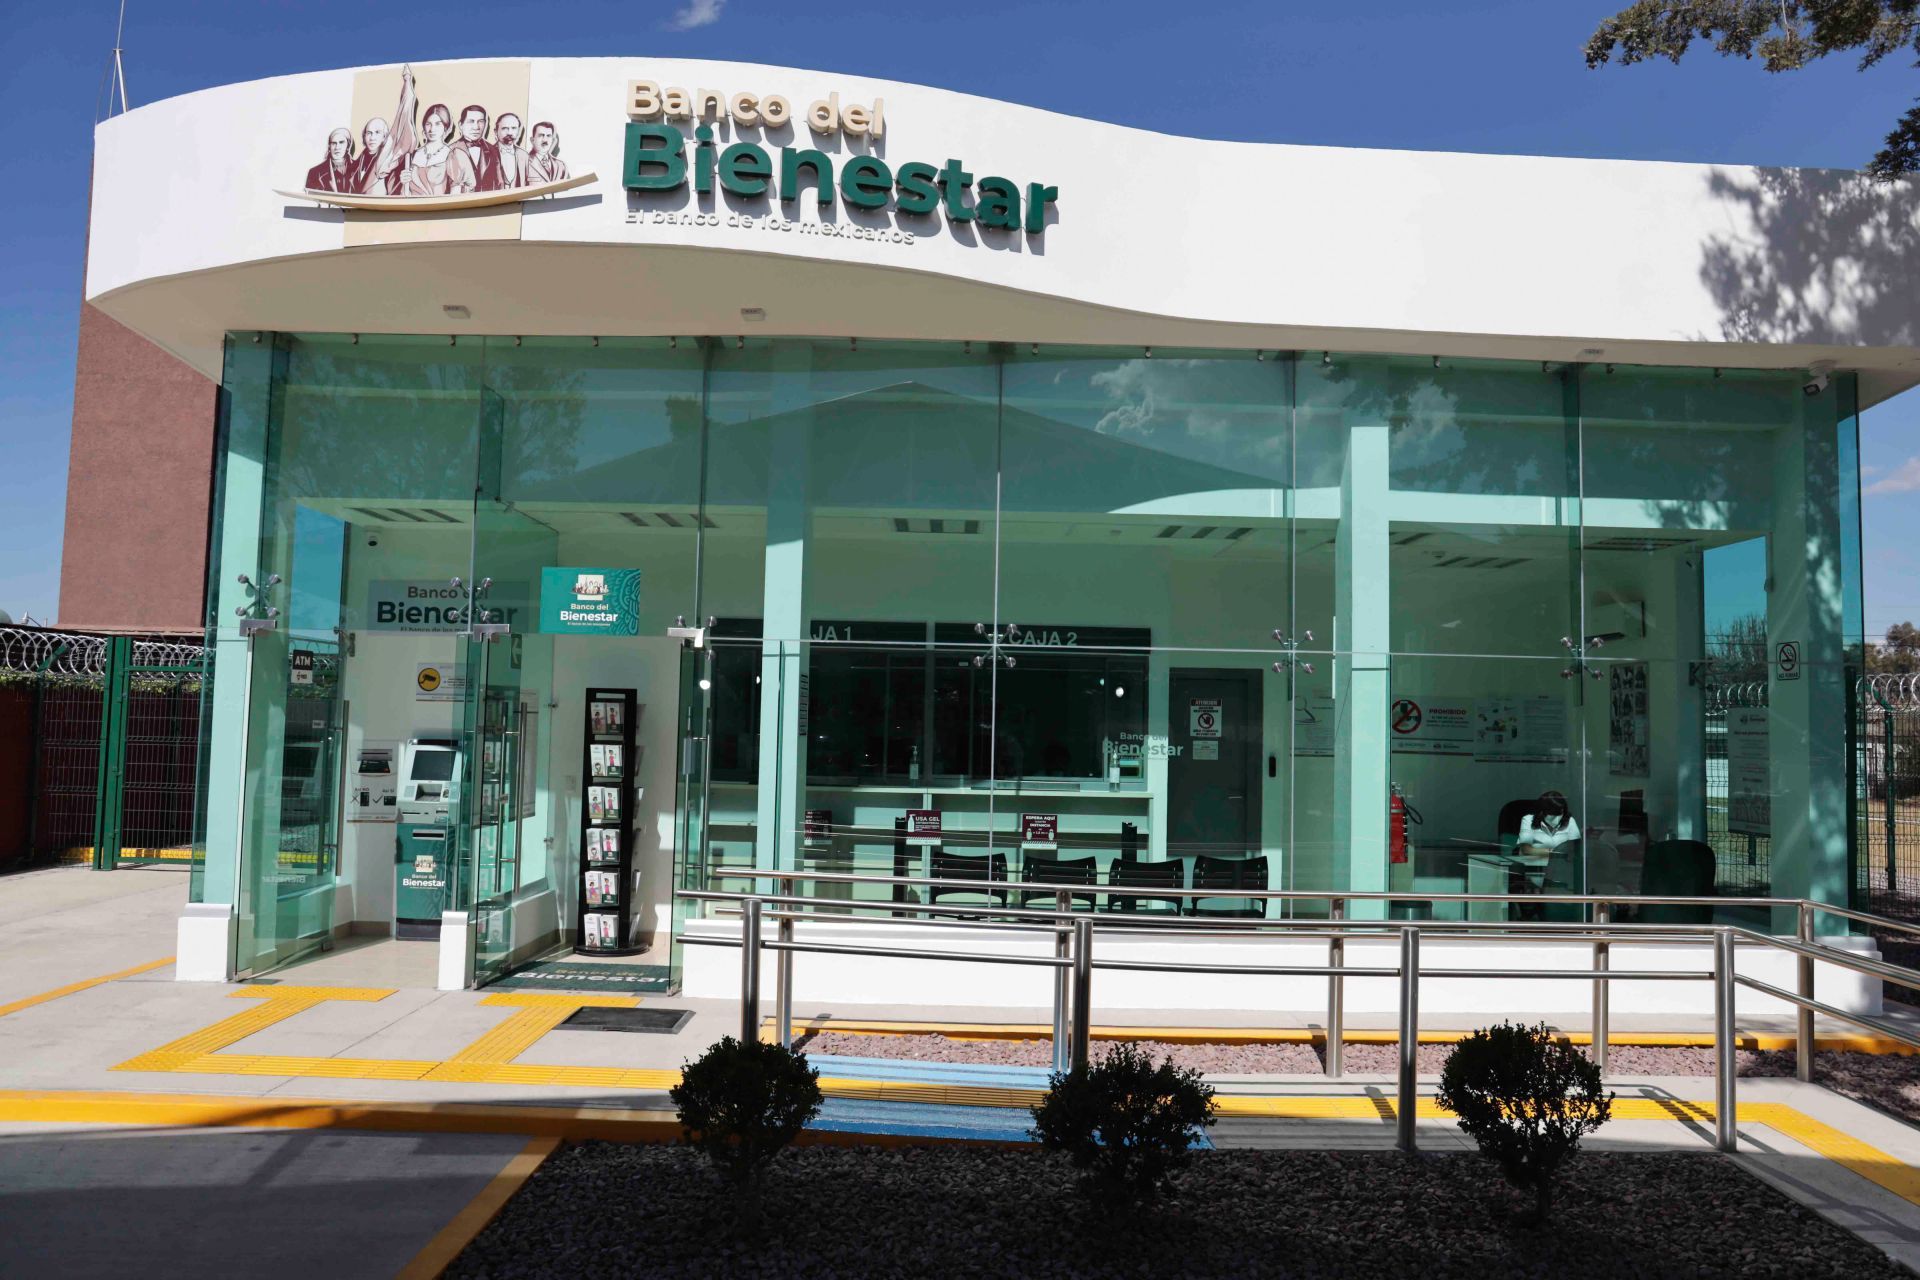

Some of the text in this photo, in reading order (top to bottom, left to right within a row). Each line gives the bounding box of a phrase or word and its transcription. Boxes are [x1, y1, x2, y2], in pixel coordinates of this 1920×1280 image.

[626, 79, 884, 139] Banco del
[622, 122, 1058, 235] Bienestar
[625, 208, 915, 246] El banco de los mexicanos
[407, 586, 458, 599] Banco
[560, 610, 619, 622] Bienestar
[1008, 629, 1078, 647] CAJA 2
[294, 655, 311, 666] ATM
[1102, 740, 1184, 757] Bienestar
[402, 878, 446, 887] Bienestar
[513, 972, 670, 983] Bienestar
